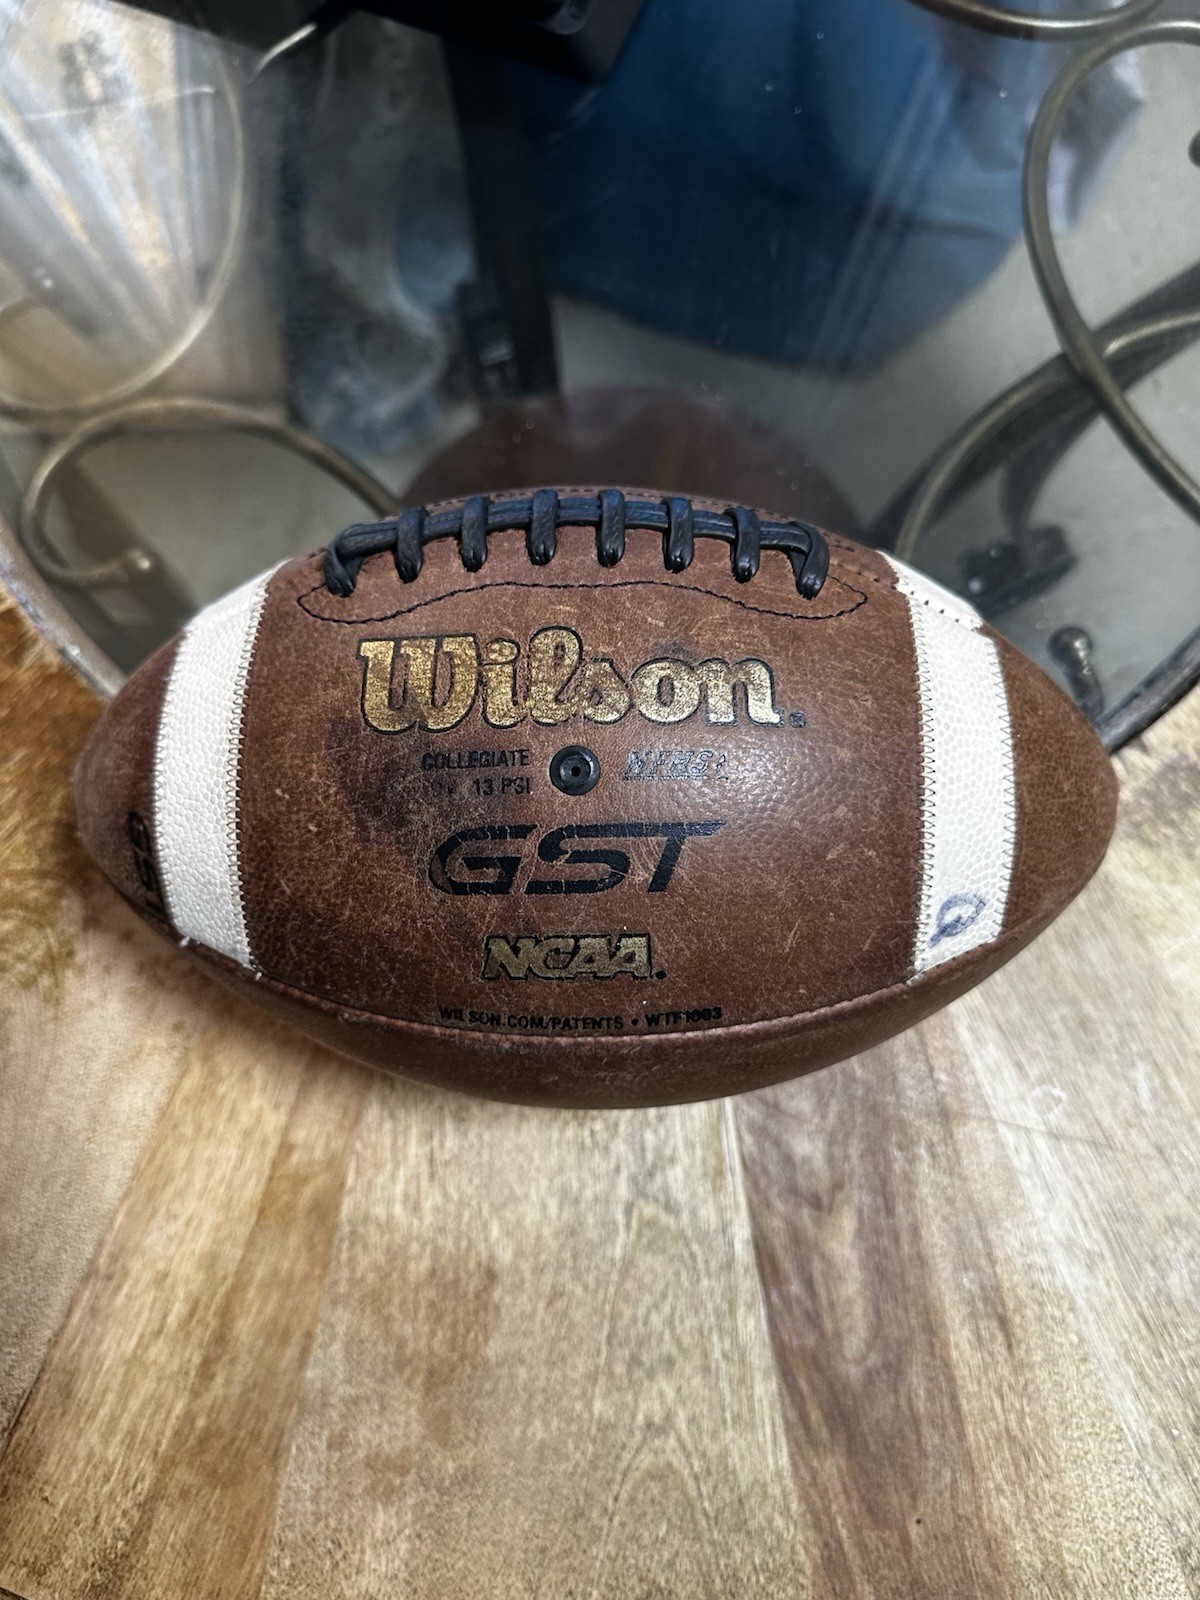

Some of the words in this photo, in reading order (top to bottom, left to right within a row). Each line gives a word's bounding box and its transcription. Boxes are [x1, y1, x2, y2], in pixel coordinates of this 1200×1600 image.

[357, 625, 785, 734] Wilson
[422, 749, 530, 770] COLLEGIATE
[474, 778, 493, 796] 13
[501, 776, 531, 795] PSI
[428, 820, 726, 896] GST
[481, 932, 652, 980] NCAA
[438, 1006, 624, 1031] WILSON.COM/PATENTS
